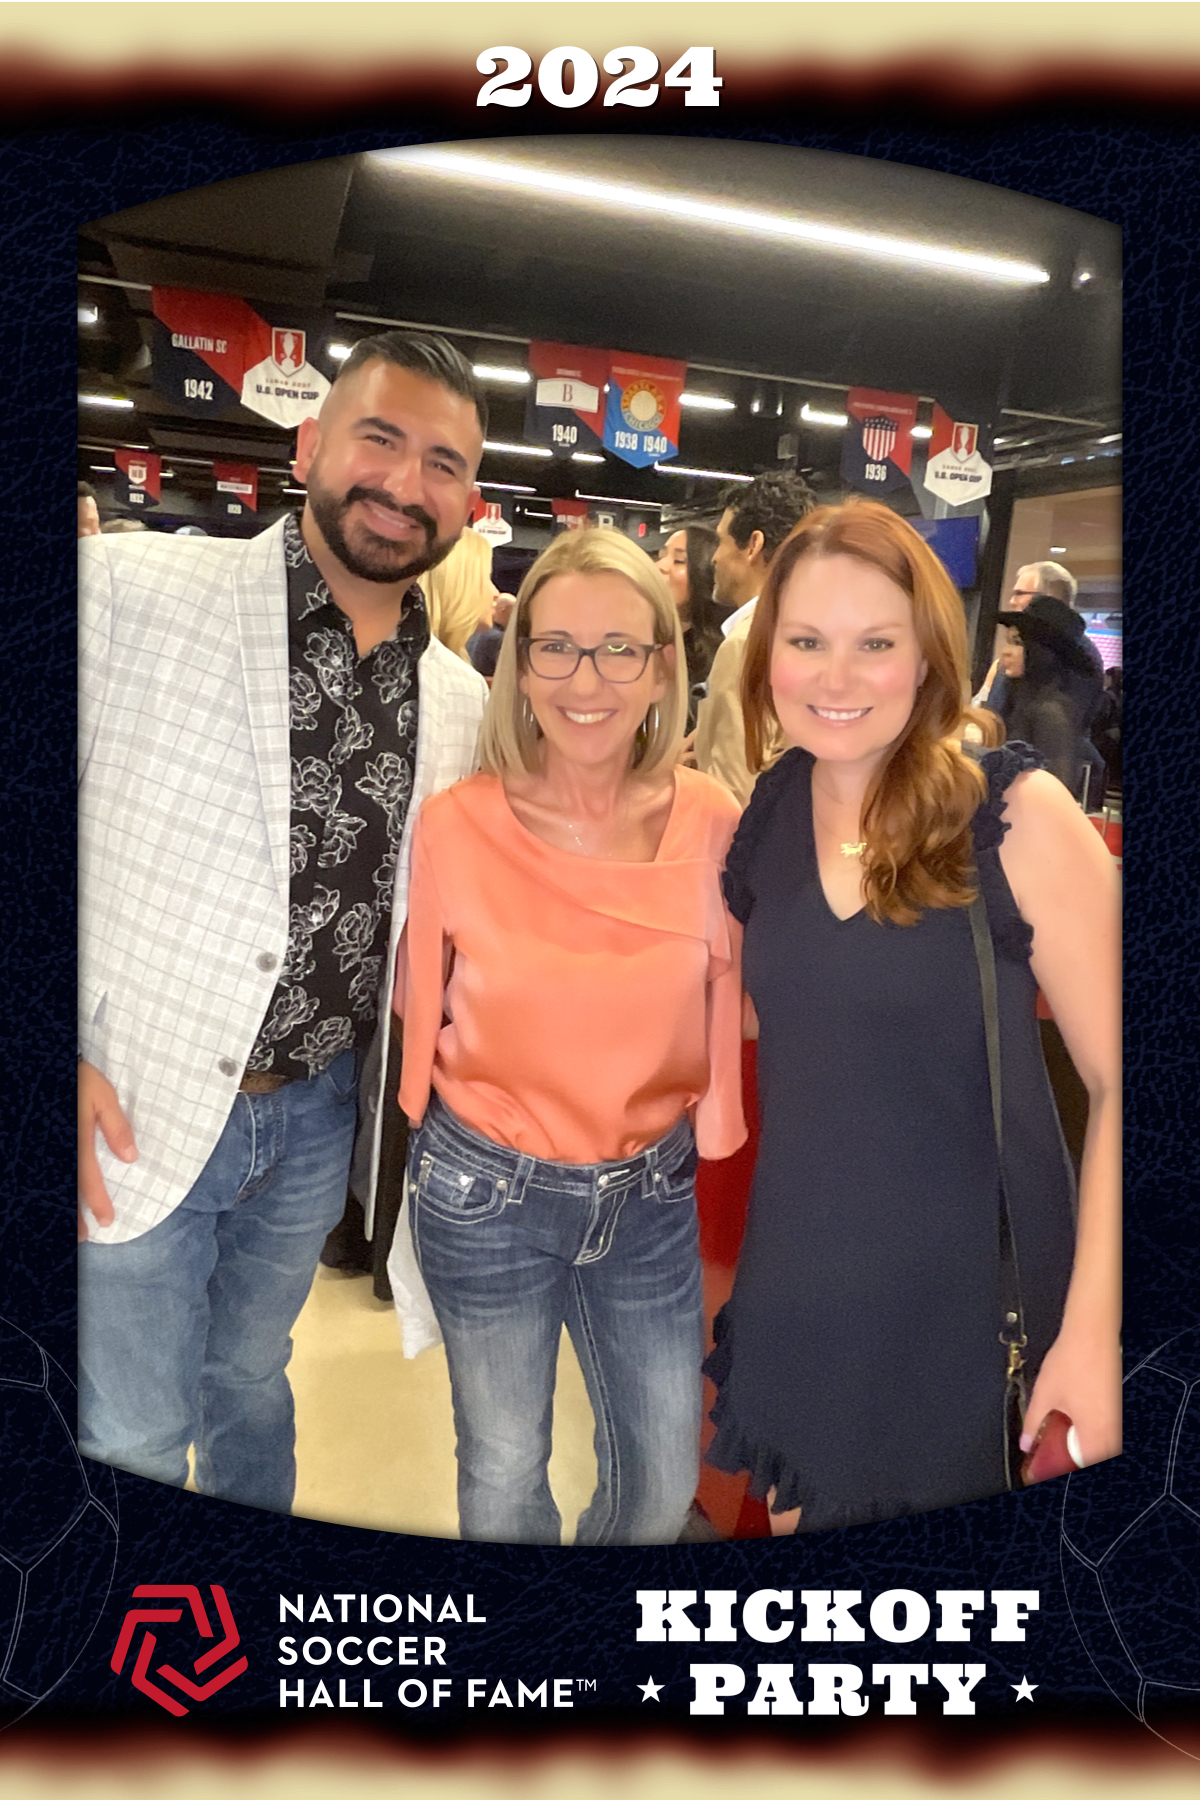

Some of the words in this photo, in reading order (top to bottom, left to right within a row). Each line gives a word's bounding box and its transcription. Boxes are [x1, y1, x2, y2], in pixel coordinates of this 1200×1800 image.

[171, 333, 214, 352] GALLATIN
[215, 339, 228, 354] SC
[184, 378, 214, 400] 1942
[275, 387, 299, 399] OPEN
[301, 391, 320, 400] CUP
[562, 383, 573, 402] B
[552, 424, 578, 444] 1940
[615, 431, 639, 450] 1938
[643, 435, 668, 453] 1940
